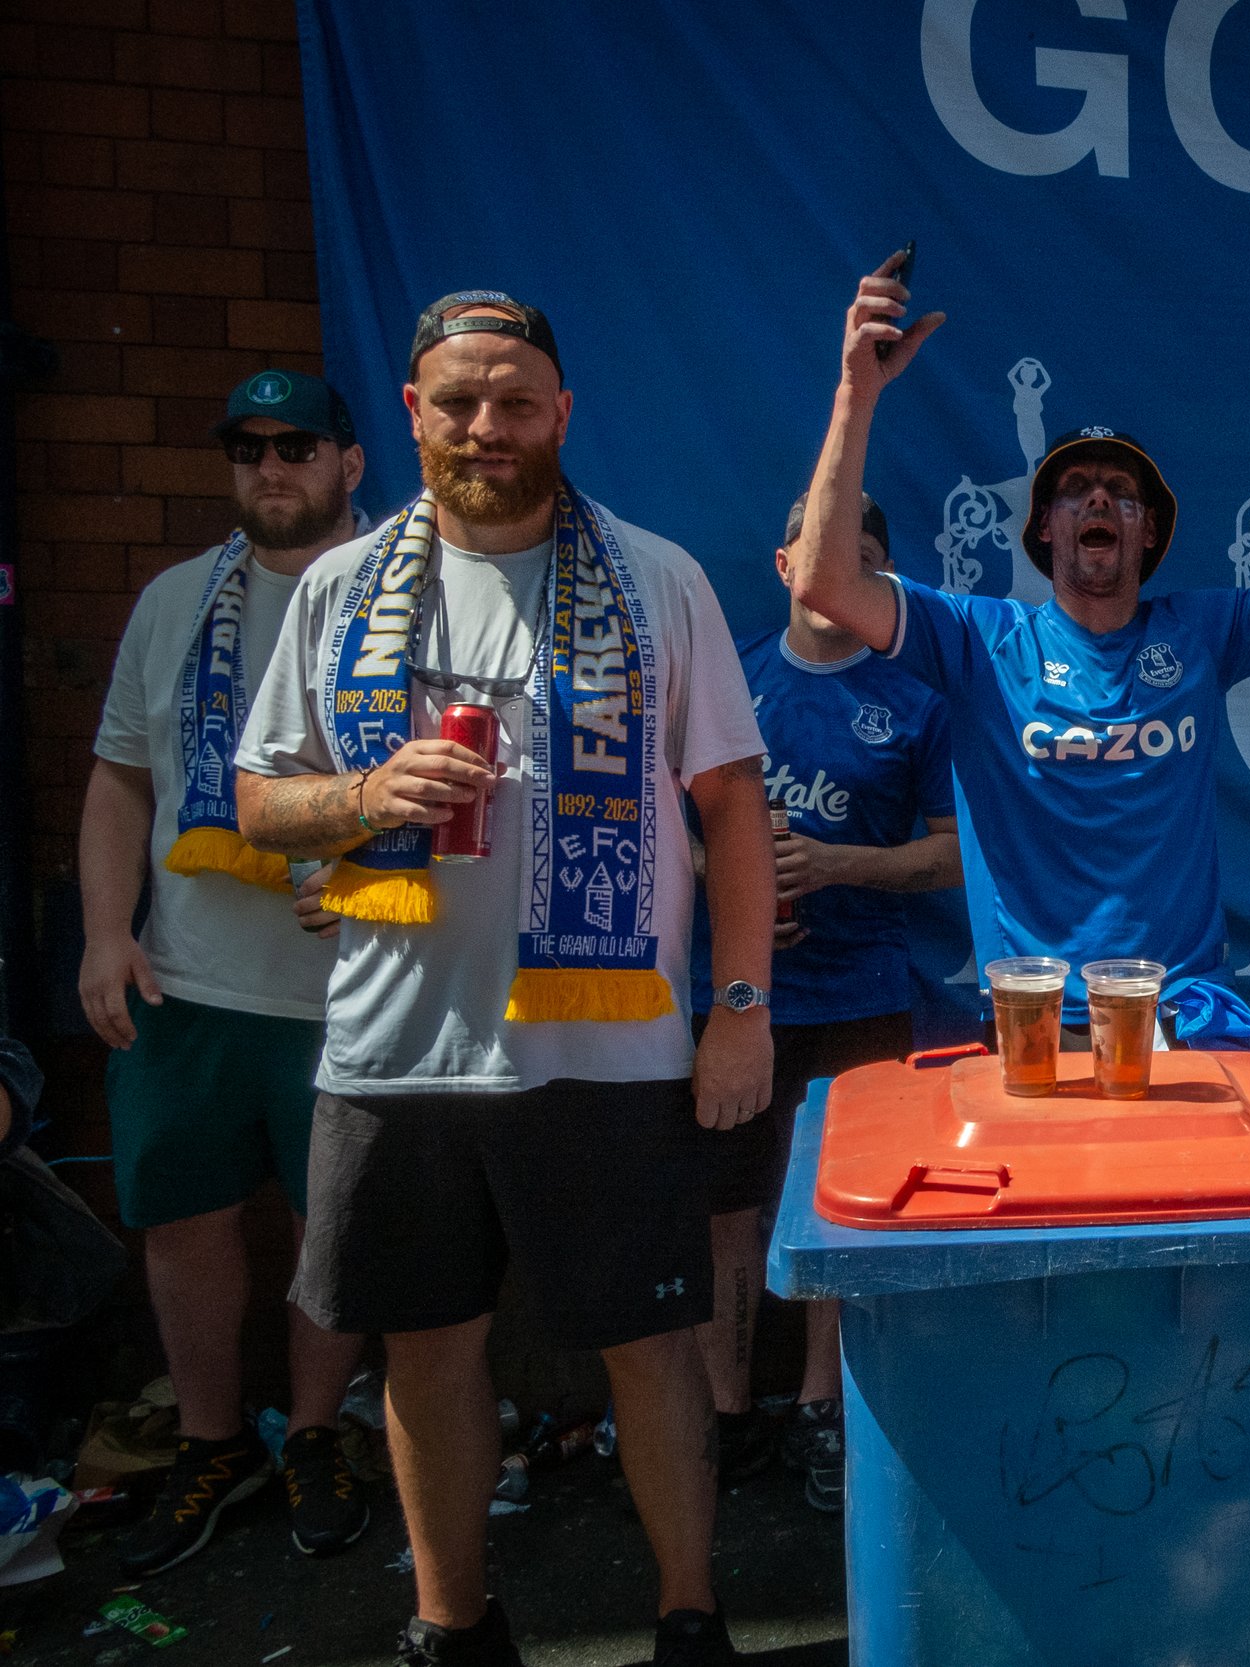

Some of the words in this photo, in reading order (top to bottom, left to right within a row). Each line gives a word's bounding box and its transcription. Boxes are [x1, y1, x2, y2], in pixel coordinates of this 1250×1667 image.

[552, 543, 574, 678] THANKS
[1150, 665, 1175, 677] Everton
[336, 689, 409, 713] 1892-2025
[629, 669, 642, 716] 133
[1022, 715, 1196, 761] CAZOO
[531, 732, 549, 793] LEAGUE
[643, 777, 657, 806] CUP
[207, 800, 228, 817] OLD
[557, 793, 639, 821] 1892-2025
[787, 810, 803, 819] om
[531, 934, 556, 954] THE
[559, 934, 597, 956] GRAND
[598, 936, 616, 956] OLD
[618, 937, 648, 957] LADY
